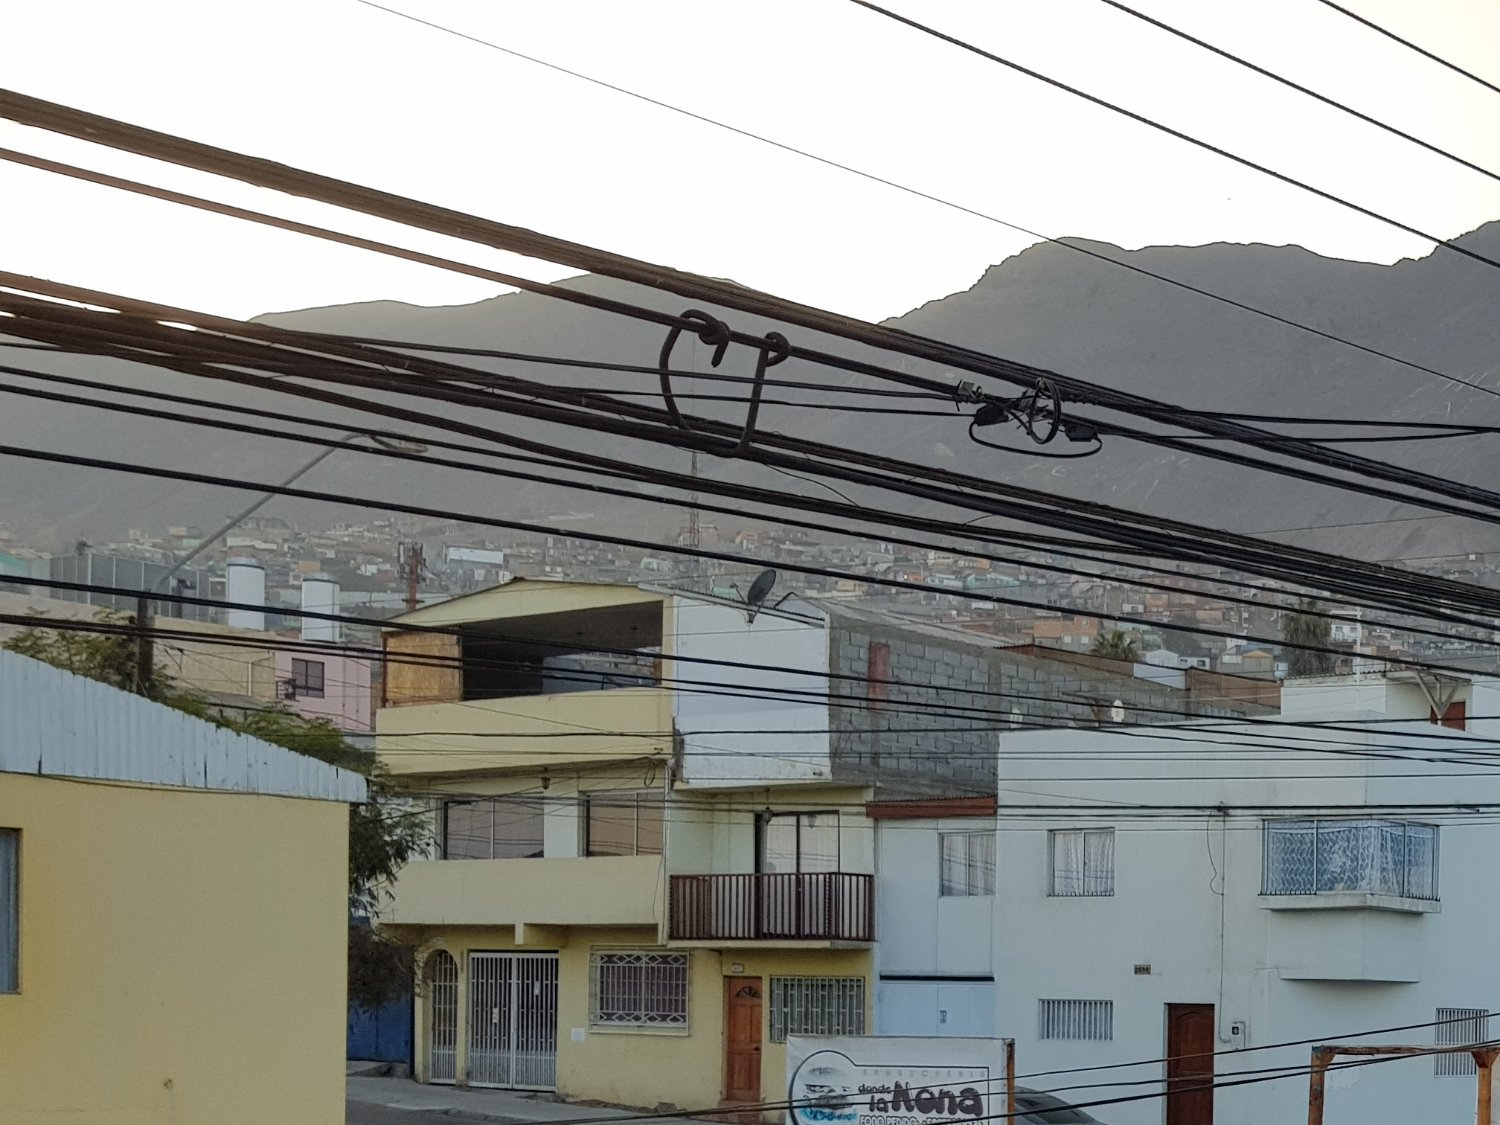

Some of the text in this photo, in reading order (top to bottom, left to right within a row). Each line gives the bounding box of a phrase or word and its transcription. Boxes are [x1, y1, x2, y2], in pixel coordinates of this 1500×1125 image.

[858, 1083, 892, 1094] donde
[869, 1080, 984, 1117] la Nona
